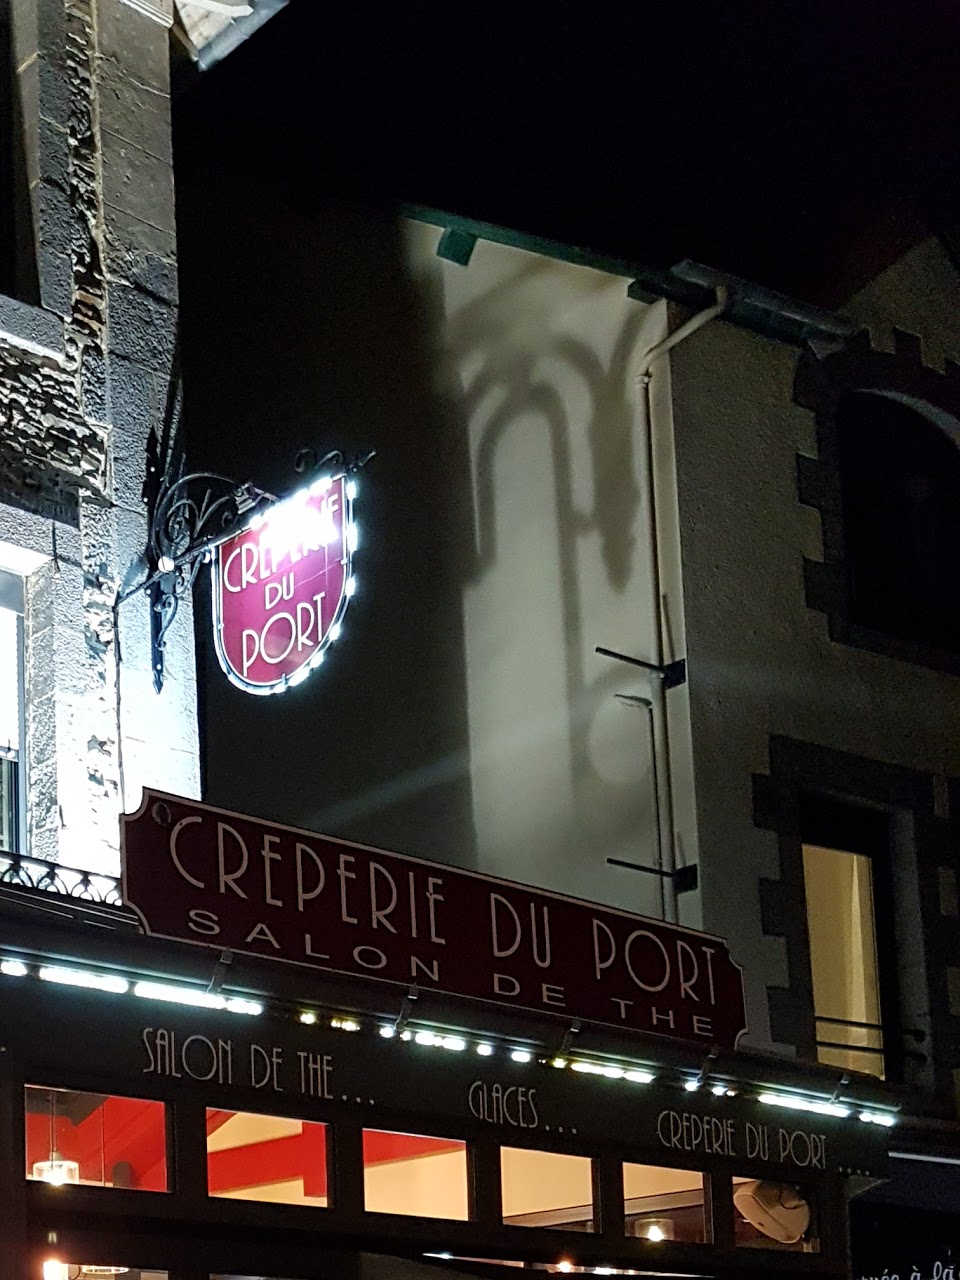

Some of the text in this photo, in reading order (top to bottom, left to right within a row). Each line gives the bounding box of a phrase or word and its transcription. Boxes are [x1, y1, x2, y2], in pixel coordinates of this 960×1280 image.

[265, 571, 295, 610] DU
[242, 592, 326, 677] PORT
[168, 815, 719, 1005] CREPERIE DU PORT
[186, 909, 715, 1037] SALON DE THE
[142, 1027, 235, 1085] SALON
[250, 1045, 285, 1093] DE
[657, 1110, 737, 1157] CREPERIE
[745, 1122, 769, 1161] DU
